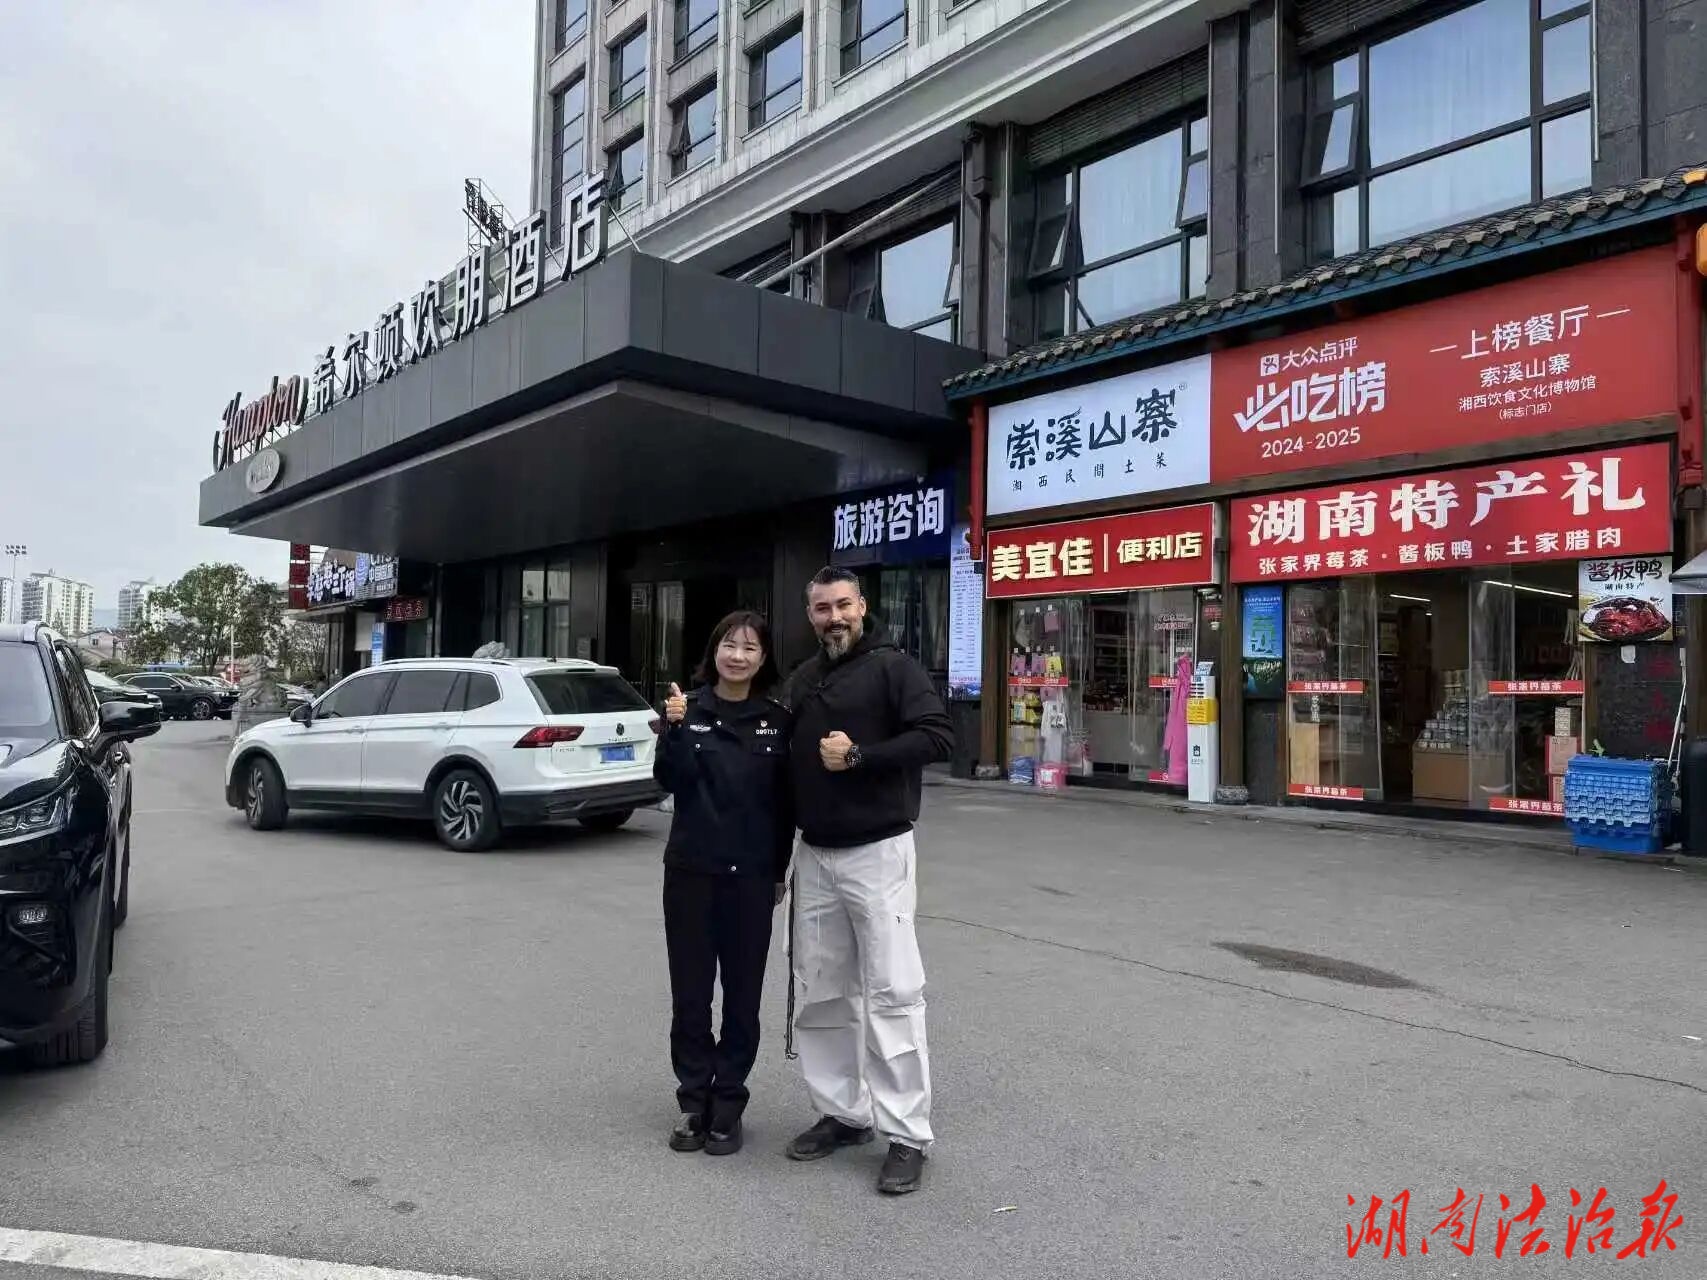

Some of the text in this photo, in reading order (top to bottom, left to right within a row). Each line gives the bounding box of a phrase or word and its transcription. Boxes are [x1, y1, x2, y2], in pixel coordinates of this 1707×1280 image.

[312, 169, 609, 411] 希尔顿欢朋酒店
[1282, 336, 1359, 372] 大众点评
[1461, 304, 1590, 360] 上榜餐厅
[1458, 375, 1597, 412] 湘西饮食文化博物馆
[1480, 353, 1571, 388] 索溪山寨
[1233, 361, 1386, 433] 必吃榜
[1006, 387, 1178, 470] 索溪山寨
[1261, 427, 1361, 458] 2024-2025
[833, 487, 944, 552] 旅游咨询
[1247, 457, 1646, 547] 湖南特产礼
[991, 531, 1203, 582] 美宜佳 便利店
[1587, 559, 1663, 581] 酱板鸭
[1604, 582, 1645, 591] 湖南特产
